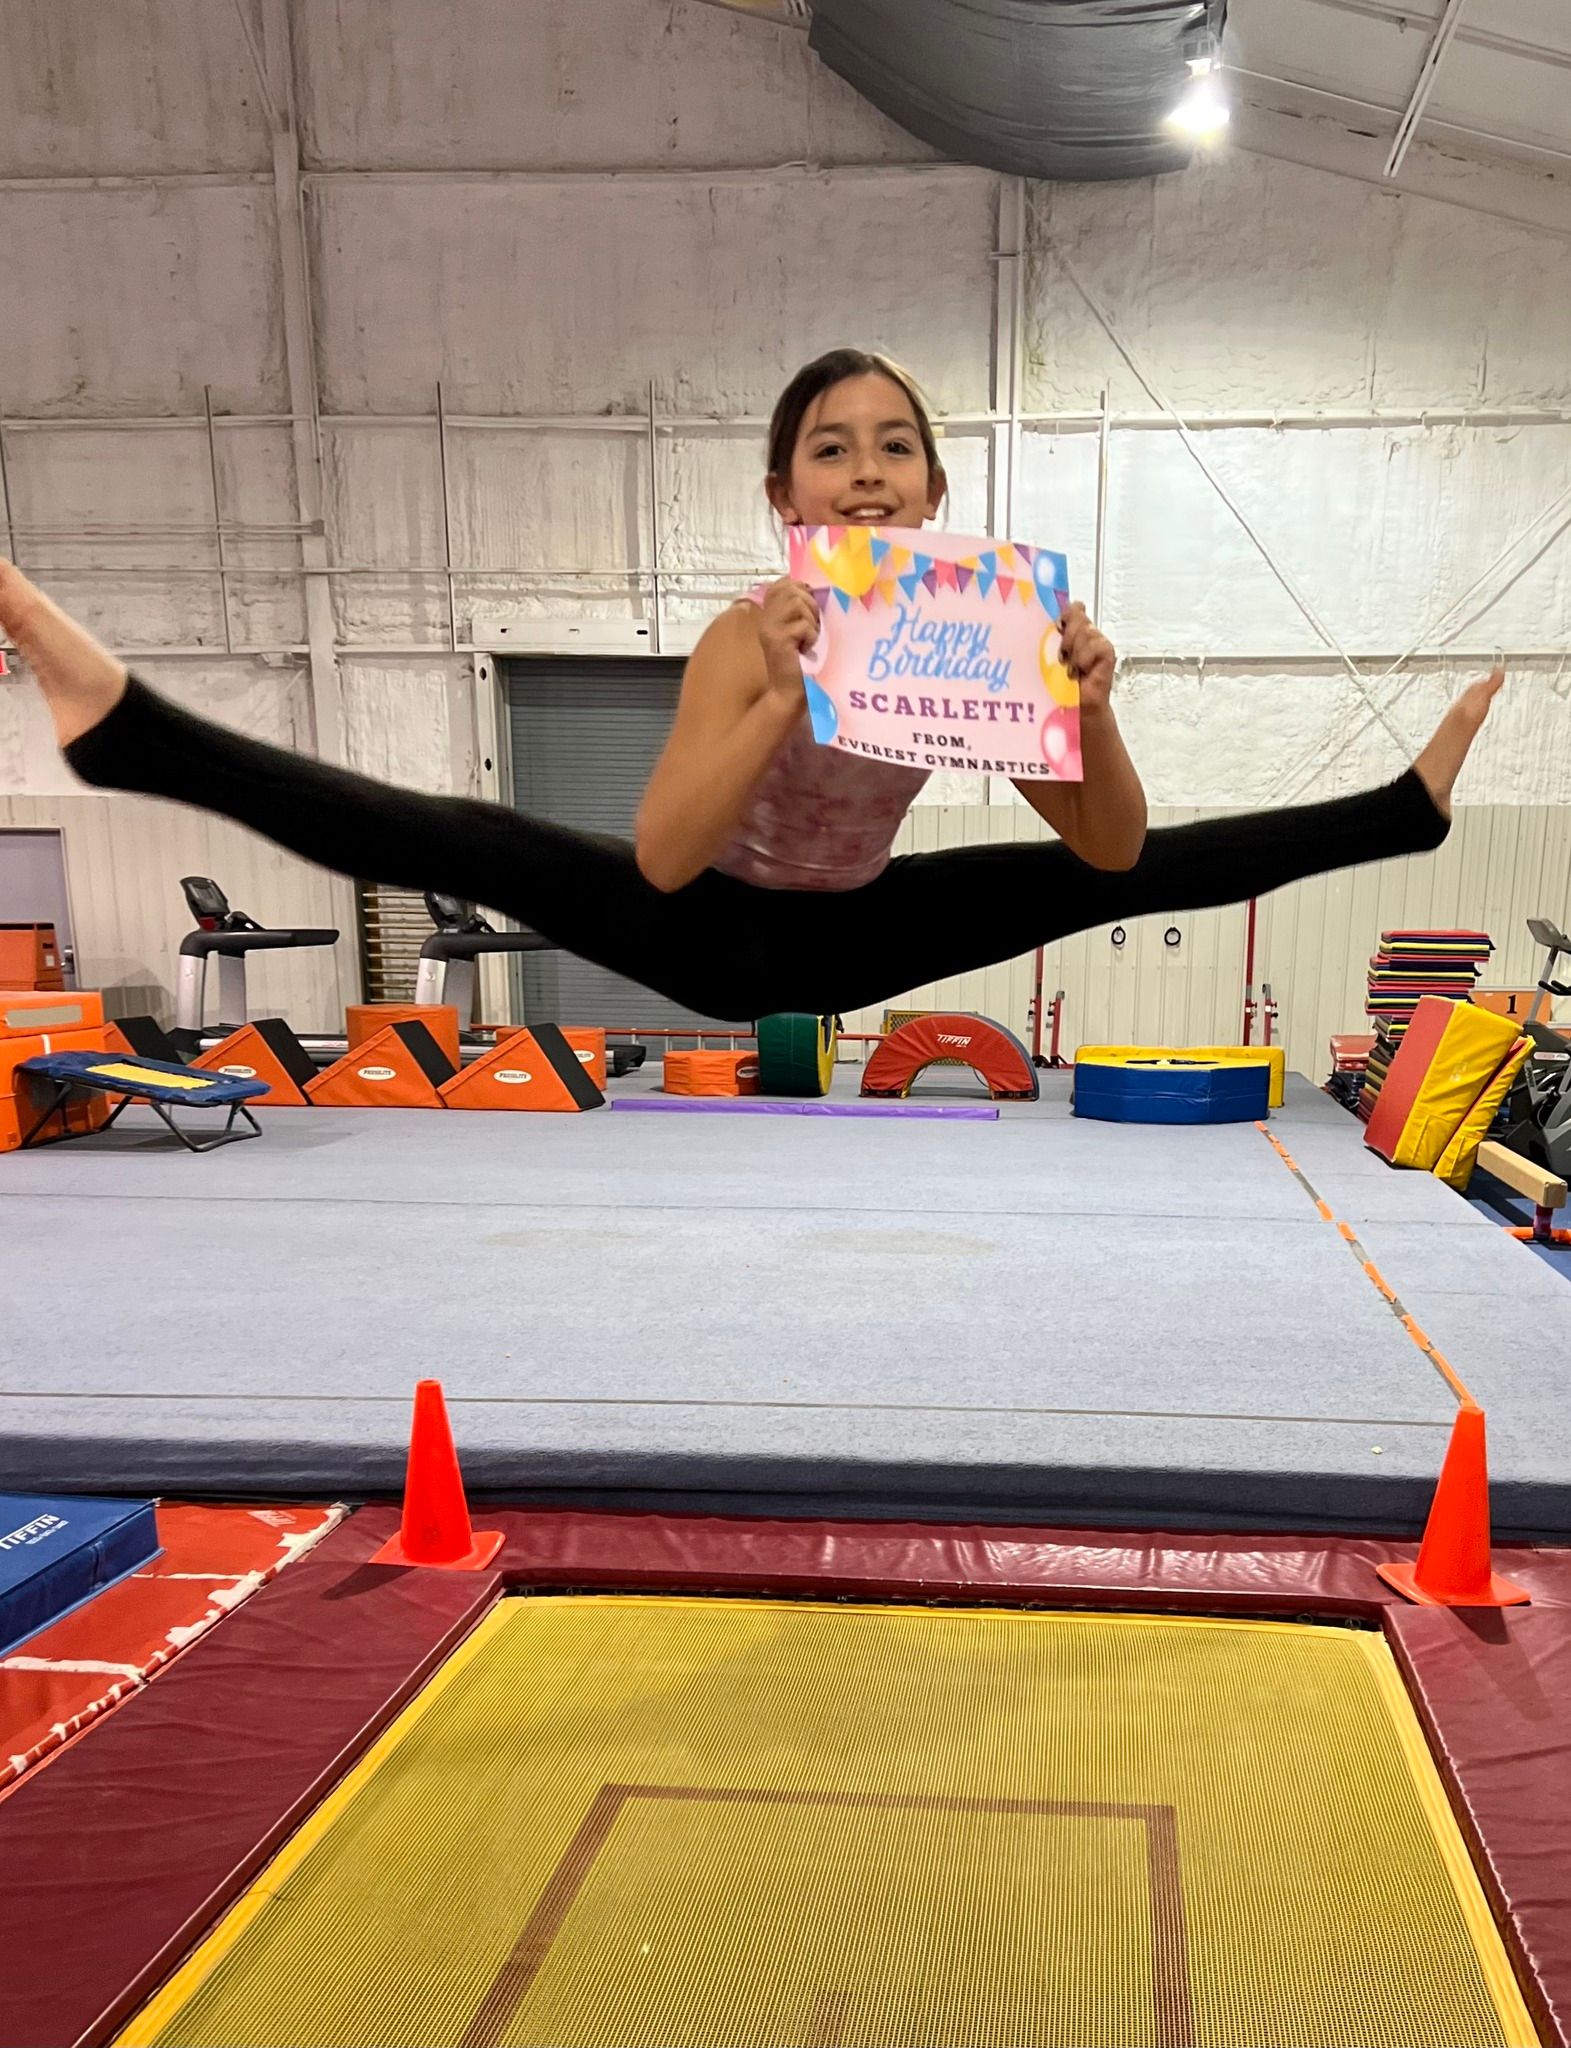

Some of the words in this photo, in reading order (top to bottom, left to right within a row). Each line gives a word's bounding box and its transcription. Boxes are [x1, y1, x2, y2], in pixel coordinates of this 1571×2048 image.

[889, 604, 992, 657] Happy
[868, 638, 1012, 693] Birthday
[849, 690, 1035, 723] SCARLETT!
[837, 735, 918, 763] EVEREST
[924, 753, 1050, 775] GYMNASTICS
[912, 732, 972, 751] FROM,
[1506, 994, 1518, 1014] 1
[937, 1033, 972, 1045] TIFFIN
